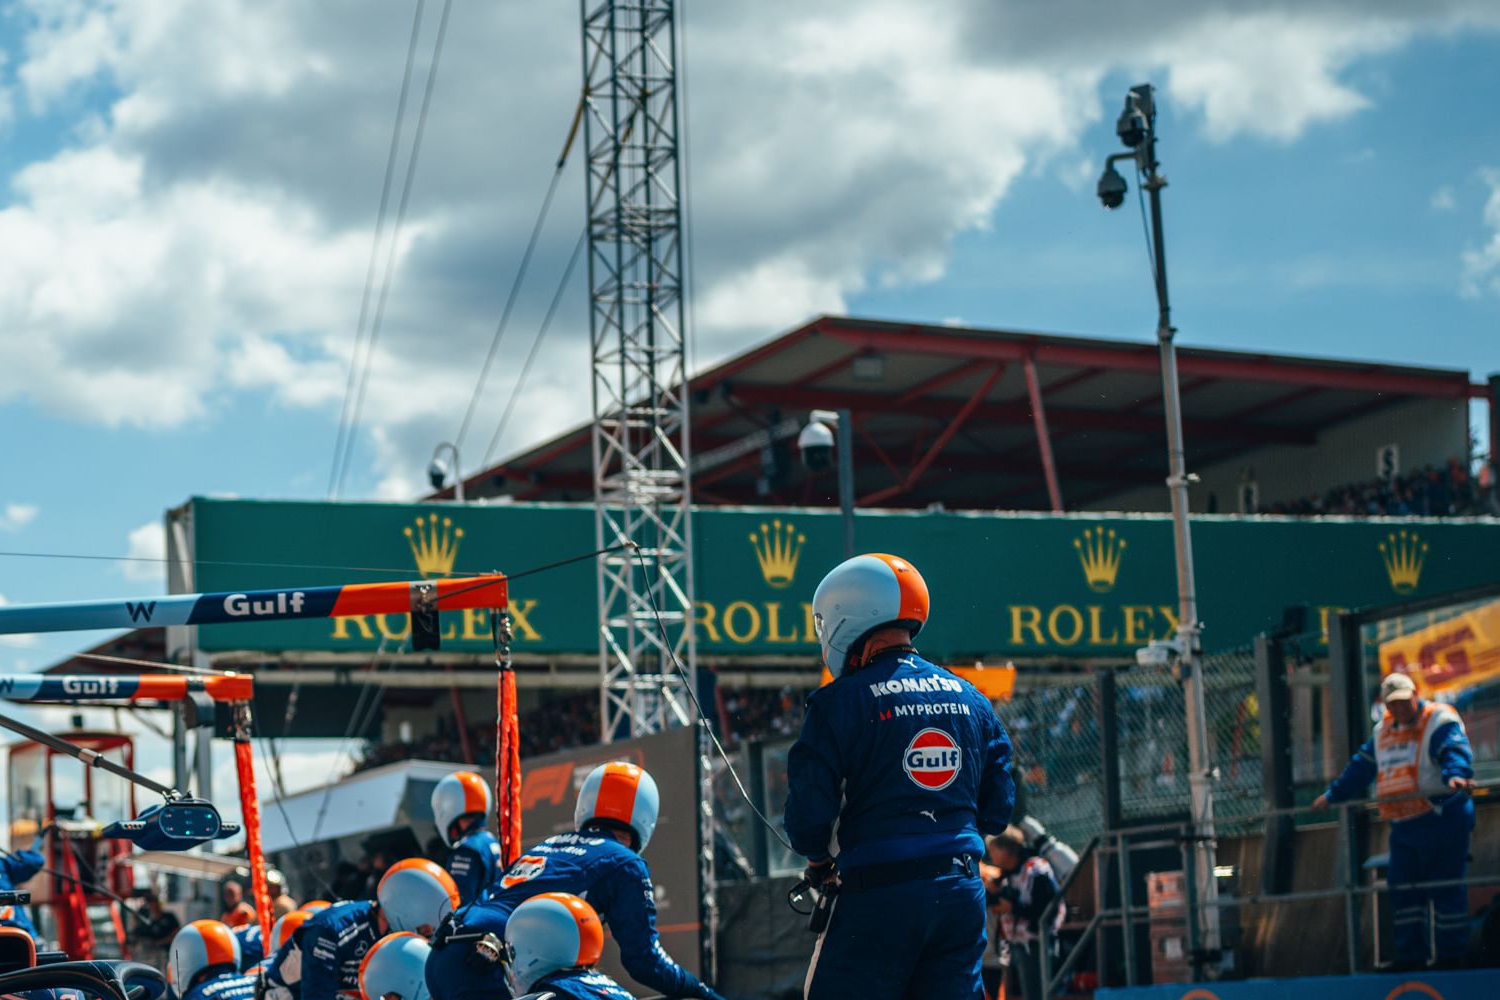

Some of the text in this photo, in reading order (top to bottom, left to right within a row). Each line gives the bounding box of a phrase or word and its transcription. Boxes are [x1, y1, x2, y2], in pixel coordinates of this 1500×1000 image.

[223, 591, 305, 616] Gulf
[331, 598, 542, 641] ROEX
[62, 675, 119, 694] Gulf
[869, 673, 963, 698] KOMATSU
[894, 702, 971, 718] MYPROTEIN
[906, 750, 958, 769] Gulf
